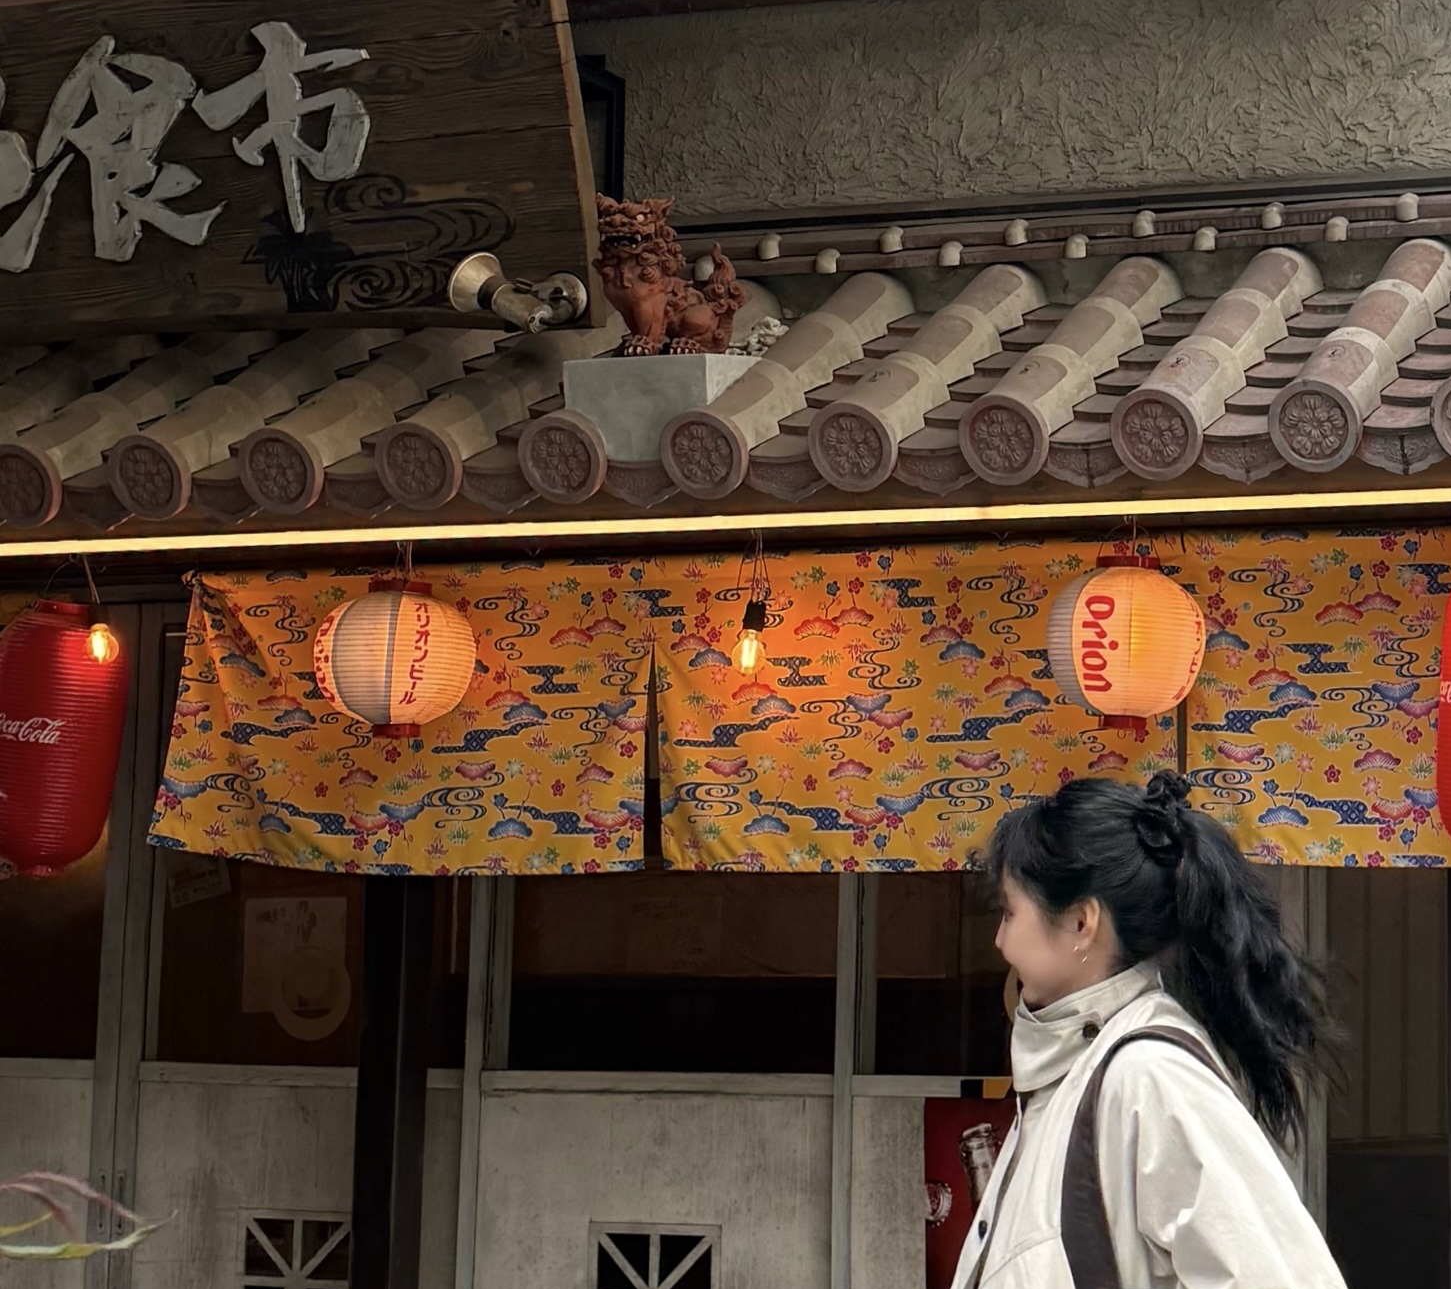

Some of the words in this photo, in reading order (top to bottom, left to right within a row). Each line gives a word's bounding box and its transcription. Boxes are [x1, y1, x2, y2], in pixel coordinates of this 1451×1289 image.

[0, 20, 370, 274] 食市
[400, 602, 431, 705] オリオンビール
[1082, 595, 1118, 692] Orion
